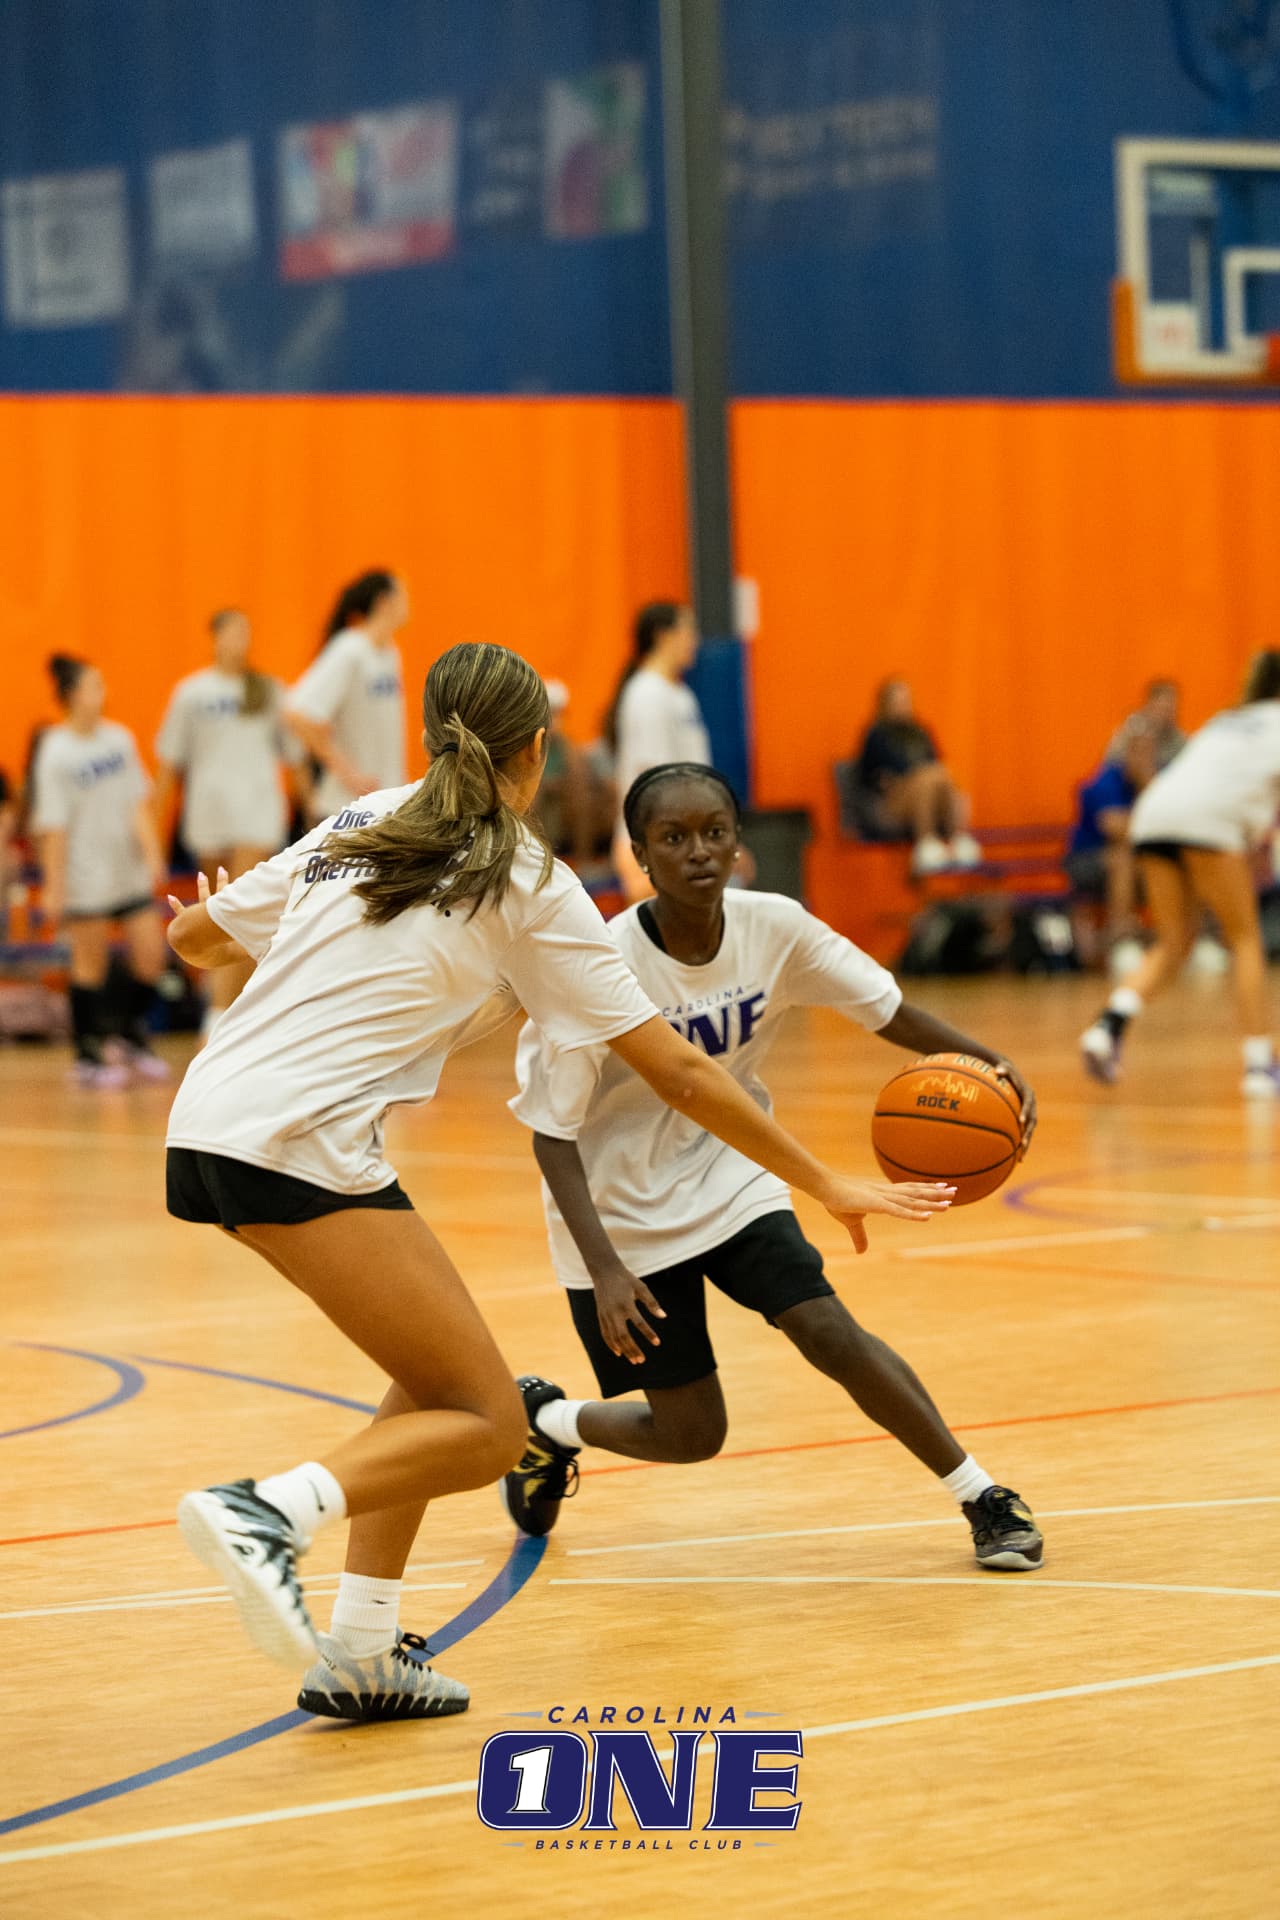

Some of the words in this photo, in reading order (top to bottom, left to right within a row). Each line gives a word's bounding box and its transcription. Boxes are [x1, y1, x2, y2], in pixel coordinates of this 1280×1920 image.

[662, 986, 744, 1016] CAROLINA
[669, 991, 765, 1056] NE
[916, 1095, 960, 1111] ROCK
